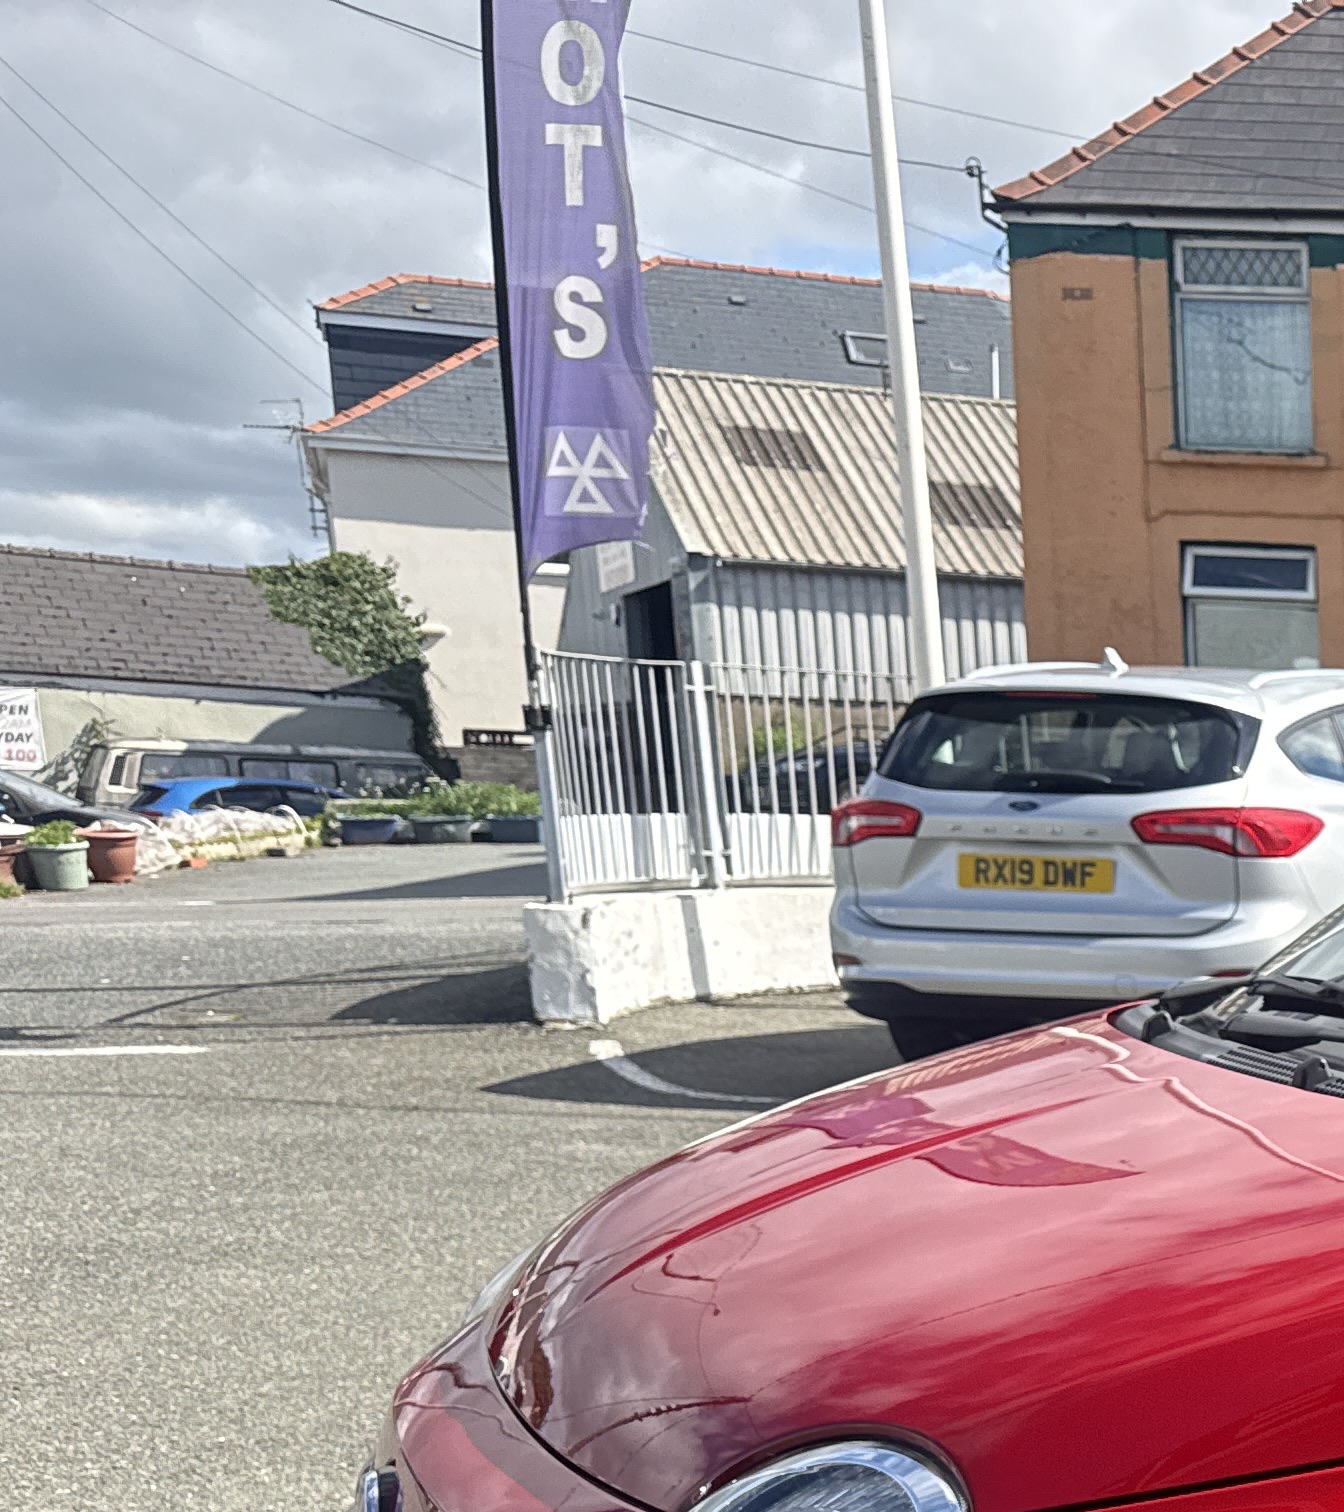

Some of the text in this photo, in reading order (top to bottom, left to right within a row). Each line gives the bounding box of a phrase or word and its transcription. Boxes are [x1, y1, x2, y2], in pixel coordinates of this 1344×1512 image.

[540, 0, 619, 360] OT'S
[0, 704, 29, 716] PEN
[974, 857, 1097, 887] RX19 DWF
